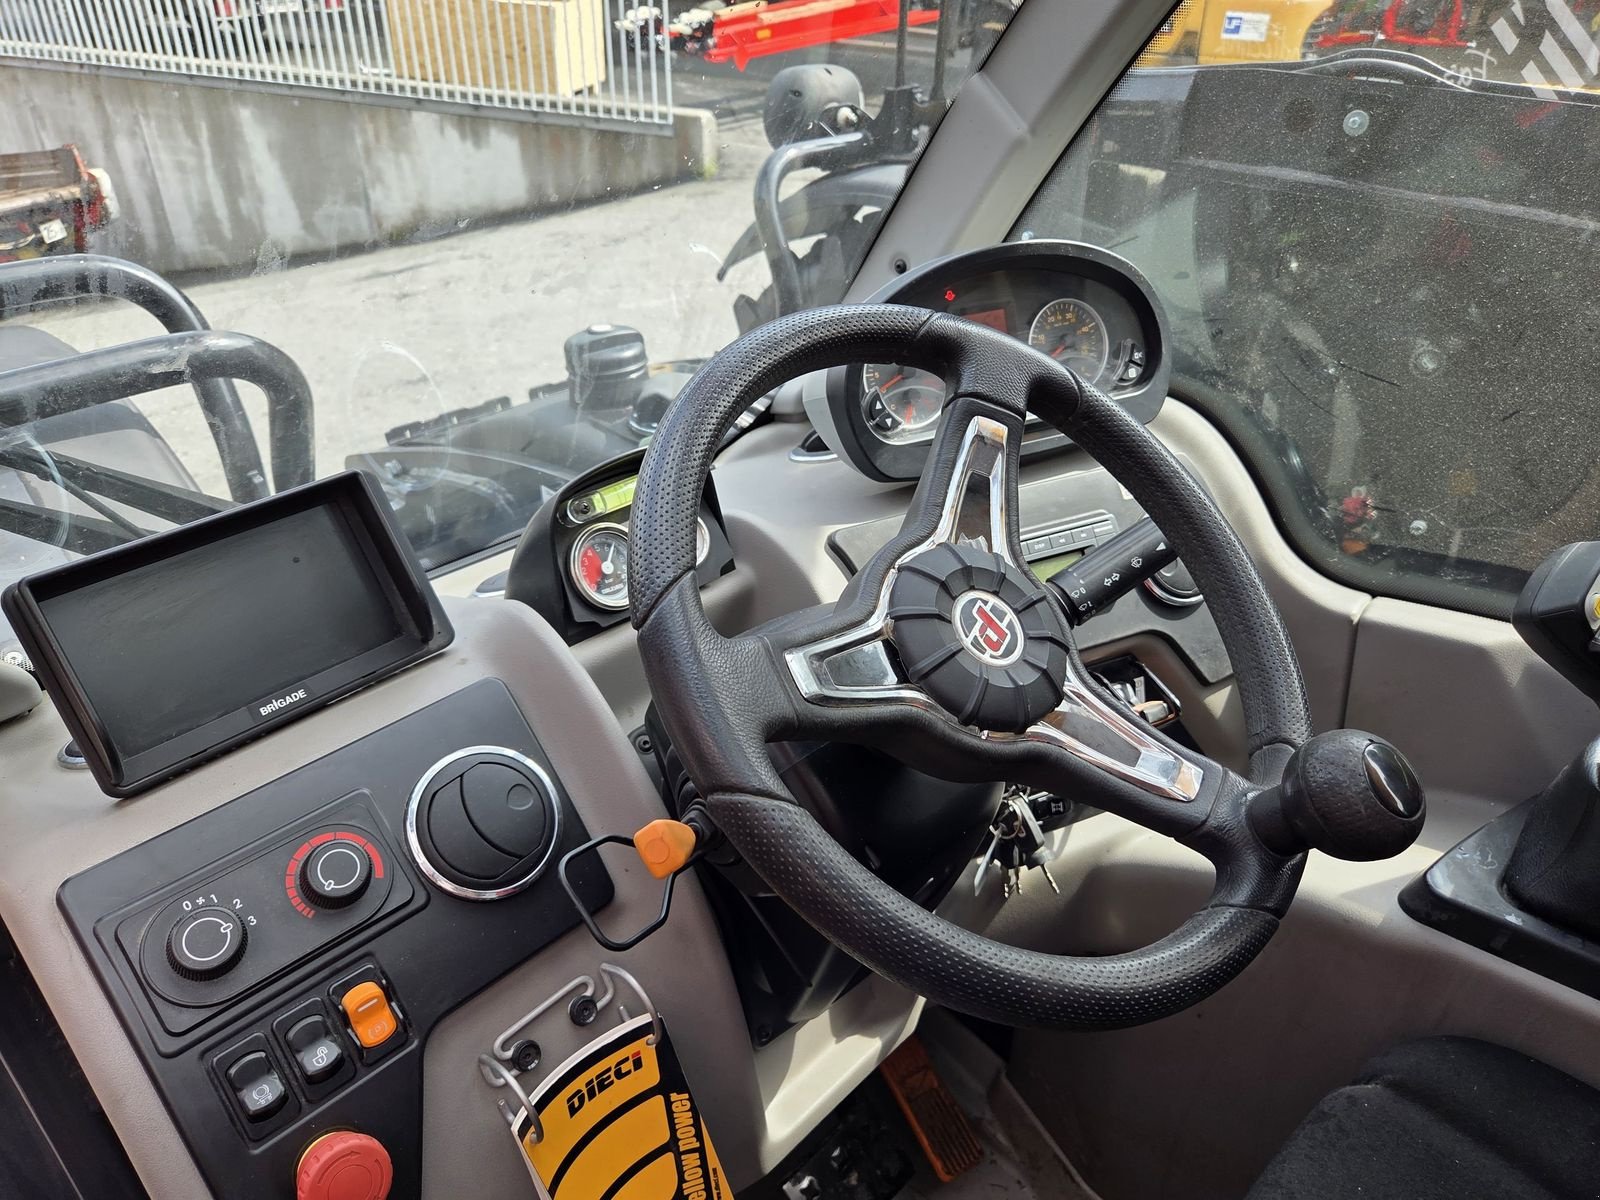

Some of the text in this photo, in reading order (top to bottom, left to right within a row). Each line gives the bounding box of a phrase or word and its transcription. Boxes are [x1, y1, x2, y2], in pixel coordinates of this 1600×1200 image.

[259, 688, 308, 716] BRIGADE
[182, 893, 257, 926] 0 1 2 3
[669, 1092, 700, 1152] power
